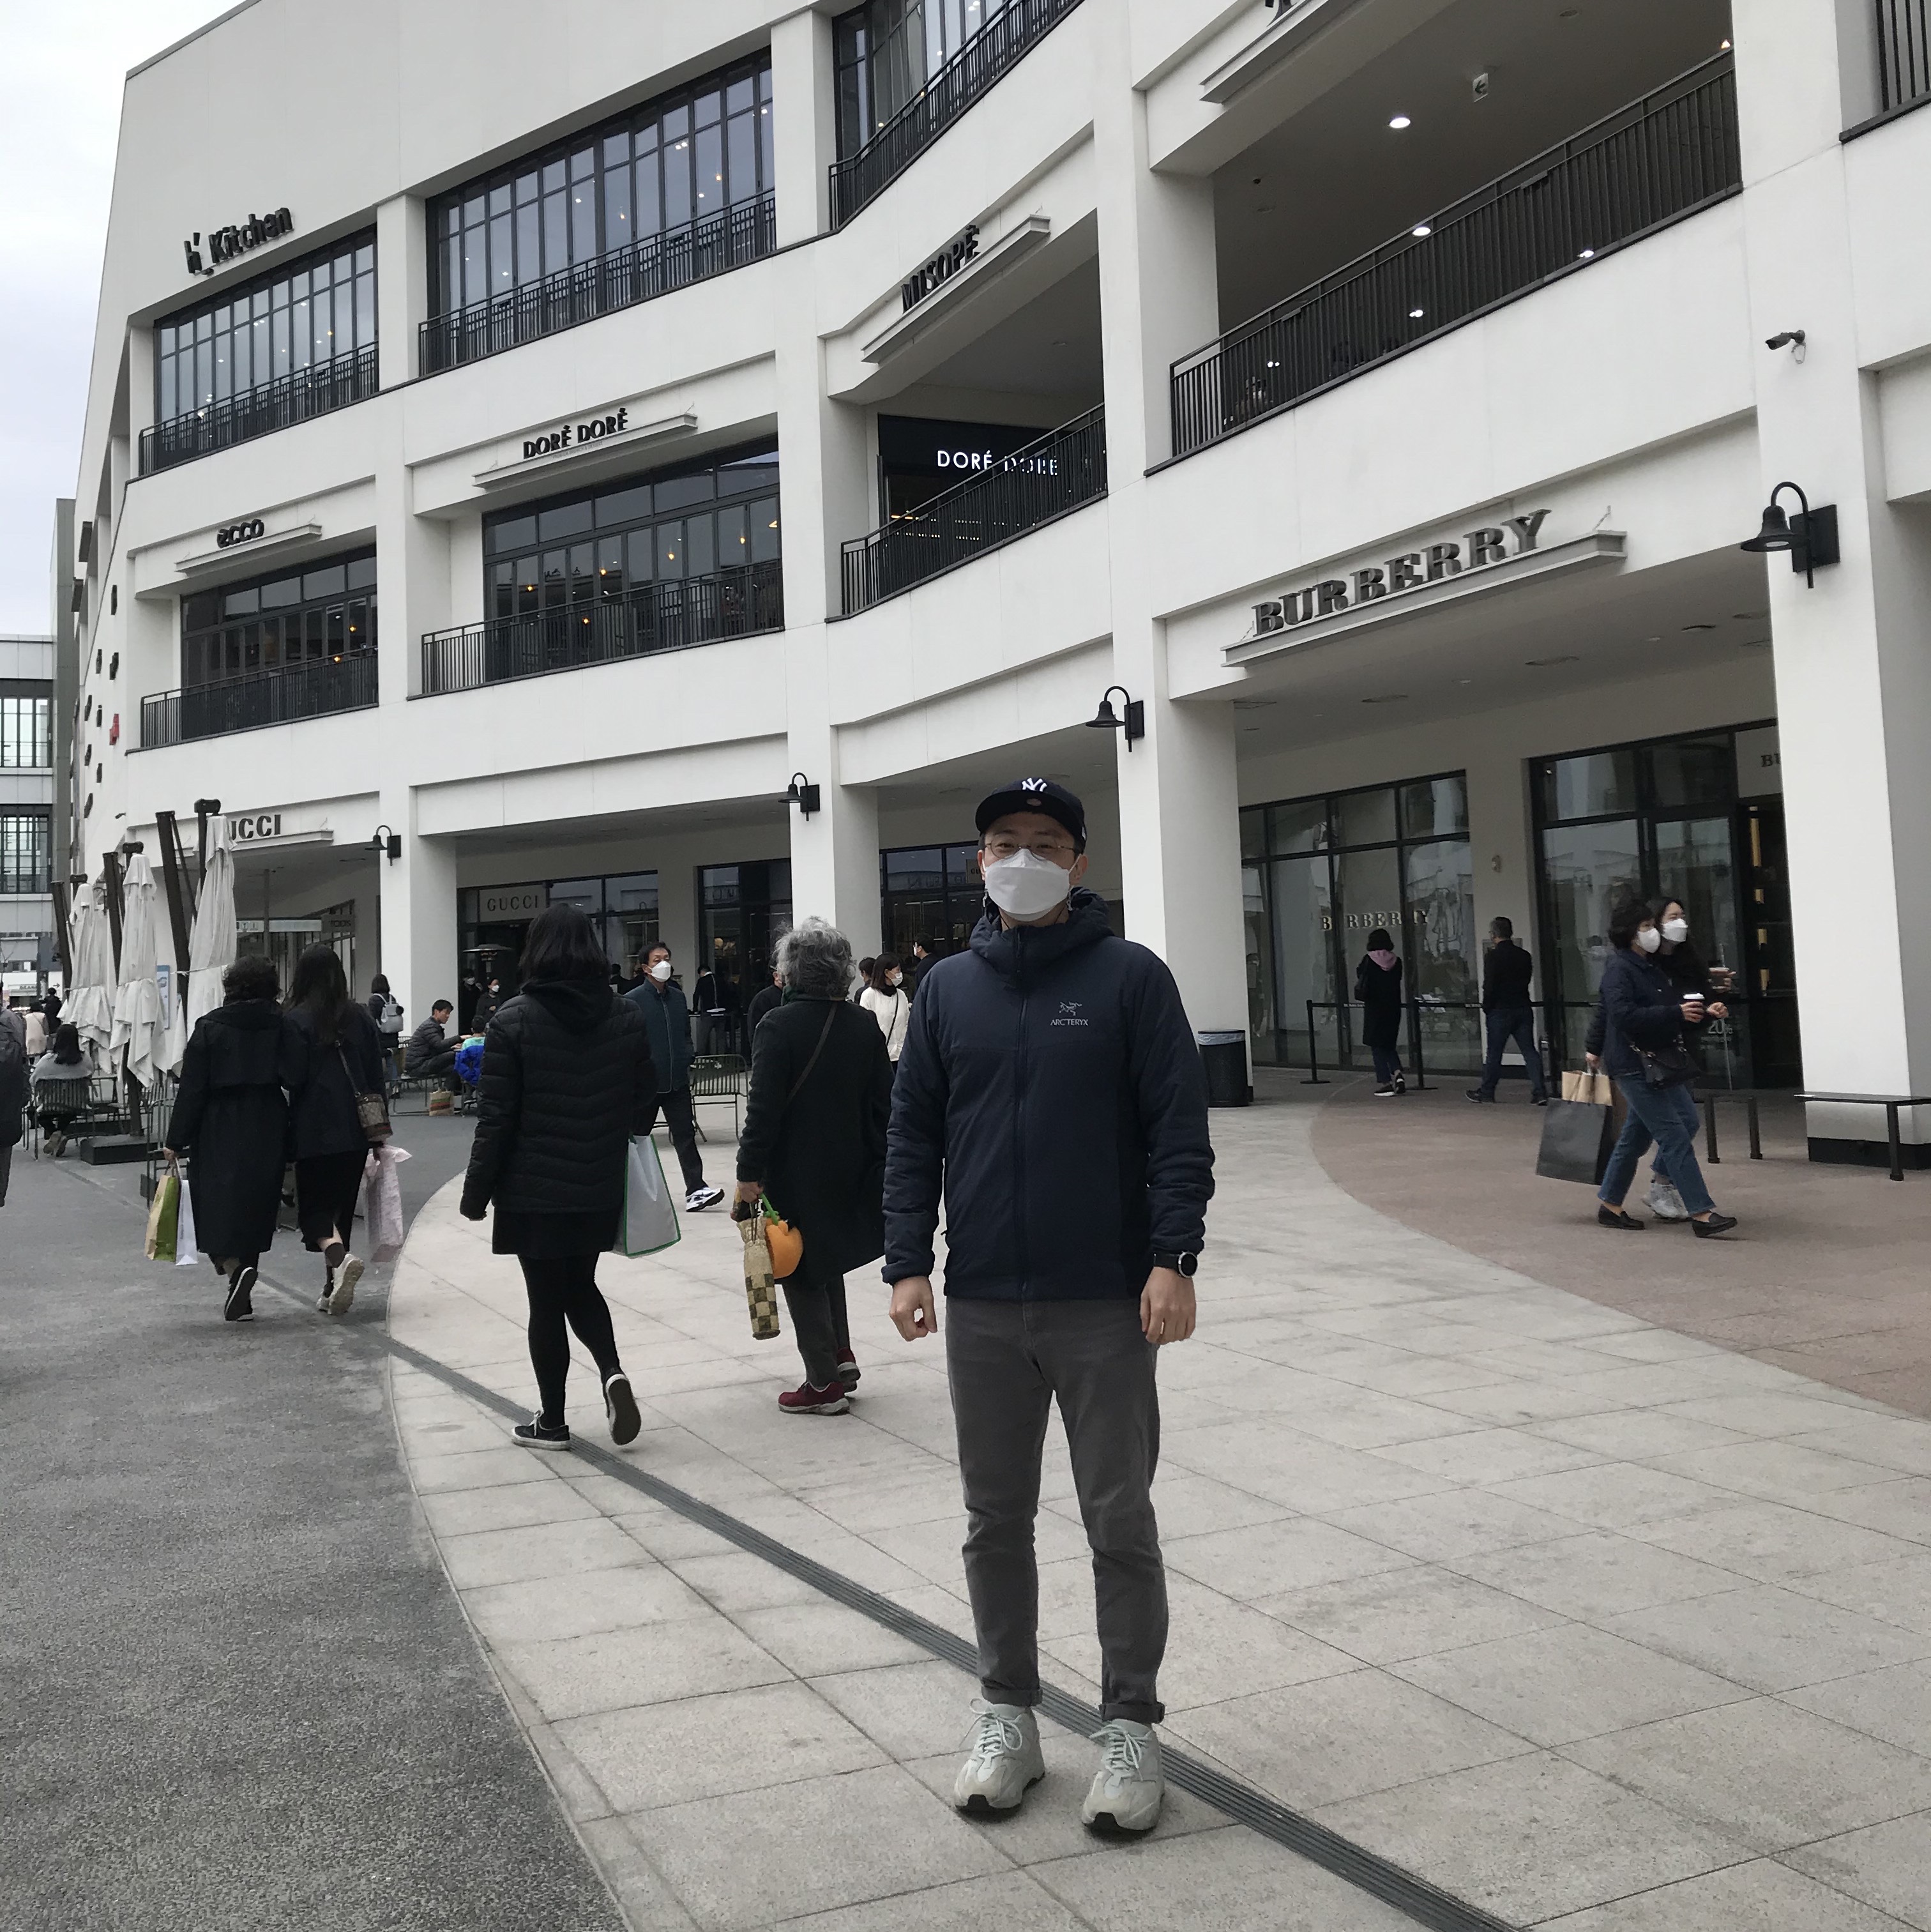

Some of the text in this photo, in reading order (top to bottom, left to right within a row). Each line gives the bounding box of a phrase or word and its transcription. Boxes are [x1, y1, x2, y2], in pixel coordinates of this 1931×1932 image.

[208, 208, 293, 263] Kitchen
[937, 450, 992, 469] DORÉ
[1251, 508, 1552, 637] BURBERRY
[231, 814, 281, 840] CCI
[487, 895, 538, 911] GUCCI
